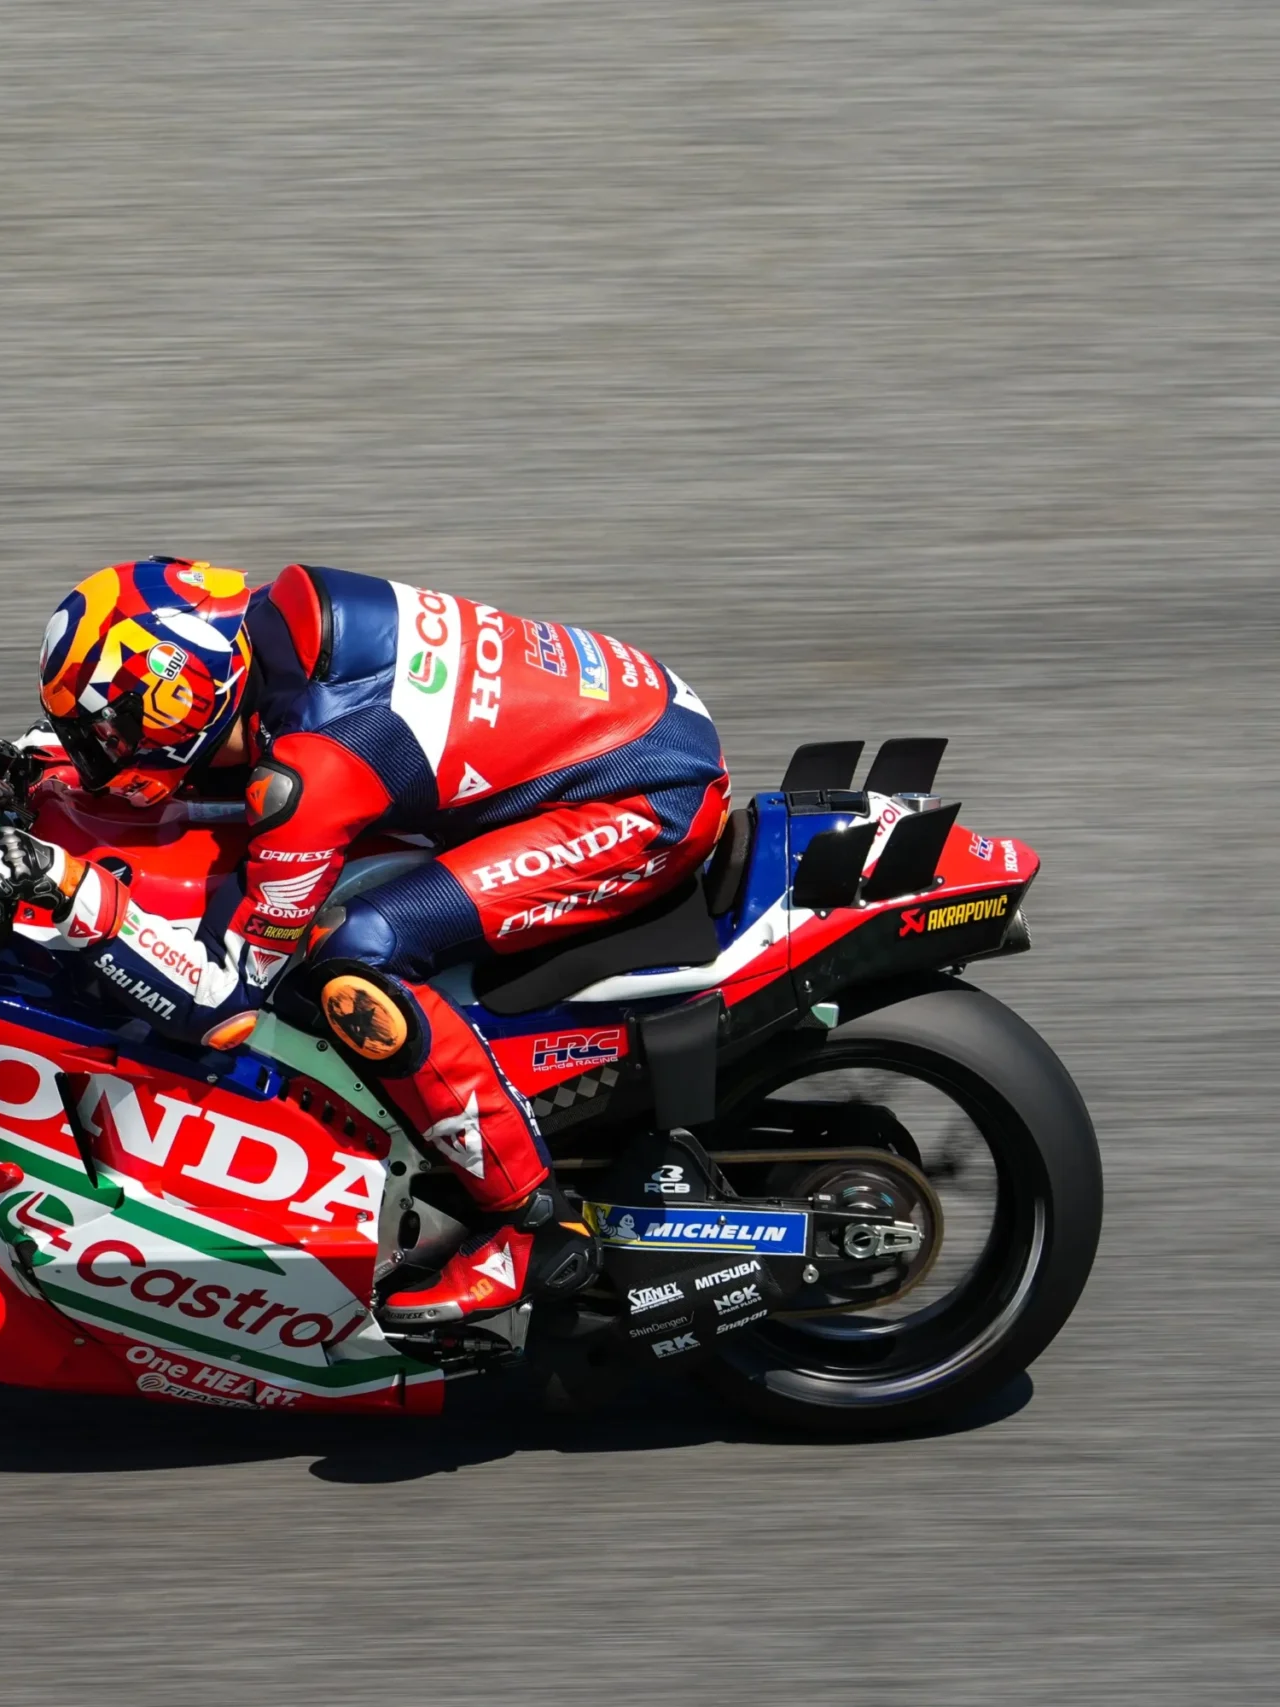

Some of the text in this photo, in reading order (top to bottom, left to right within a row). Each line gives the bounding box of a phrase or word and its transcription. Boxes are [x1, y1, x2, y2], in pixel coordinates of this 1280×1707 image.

[163, 650, 186, 680] agv
[621, 661, 640, 688] One
[259, 848, 336, 863] DAINESE
[472, 812, 655, 892] HONDA
[255, 902, 316, 919] HONDA
[94, 953, 177, 1020] Satu HATI.
[533, 1029, 621, 1067] HRC
[533, 1056, 619, 1073] Honda RACING
[644, 1183, 691, 1194] RCB
[644, 1222, 787, 1242] MICHELIN
[694, 1260, 762, 1290] MITSUBA
[76, 1239, 367, 1348] Castrol
[470, 1278, 495, 1302] 10
[627, 1281, 684, 1310] STANLEY
[713, 1283, 760, 1311] NGK
[716, 1308, 768, 1335] Snap-on
[718, 1303, 740, 1316] SPARK
[628, 1315, 688, 1339] ShinDengen
[651, 1331, 699, 1356] RK
[125, 1346, 303, 1407] One HEART.
